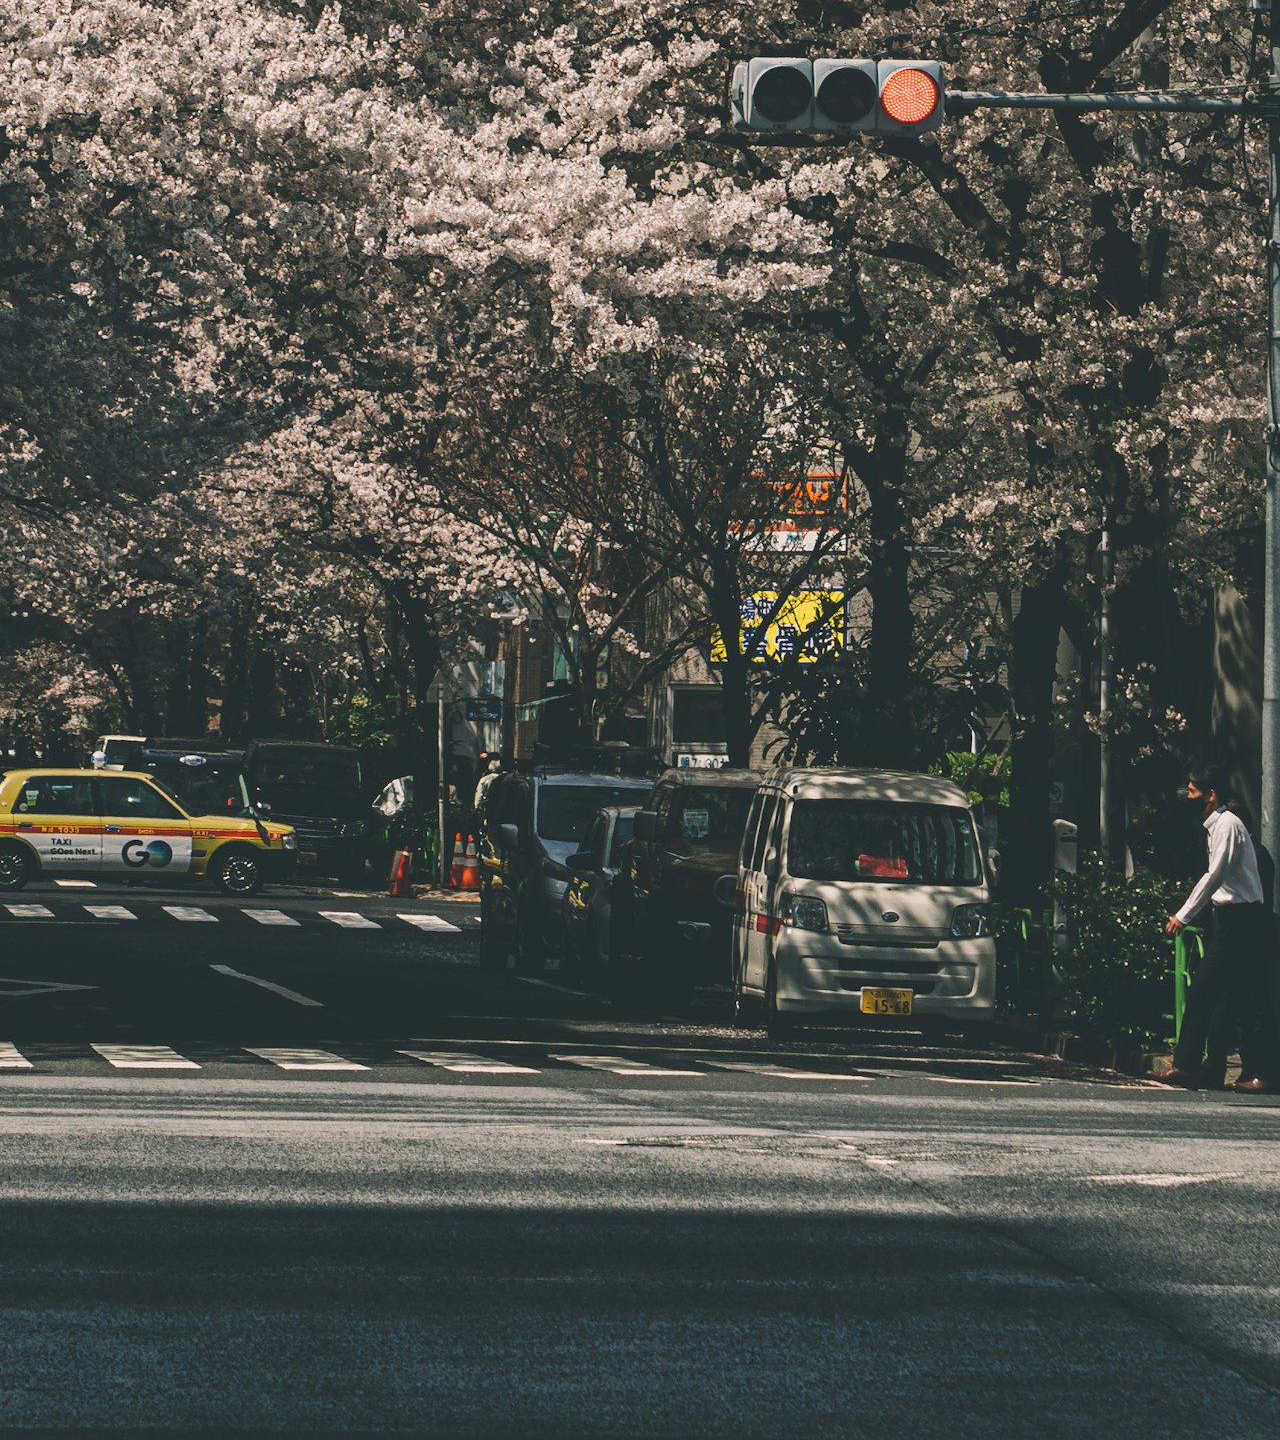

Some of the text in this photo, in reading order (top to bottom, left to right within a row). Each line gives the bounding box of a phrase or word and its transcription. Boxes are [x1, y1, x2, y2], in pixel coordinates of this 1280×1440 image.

[51, 838, 72, 846] TAXI
[75, 847, 98, 856] Next.
[121, 839, 173, 868] GO
